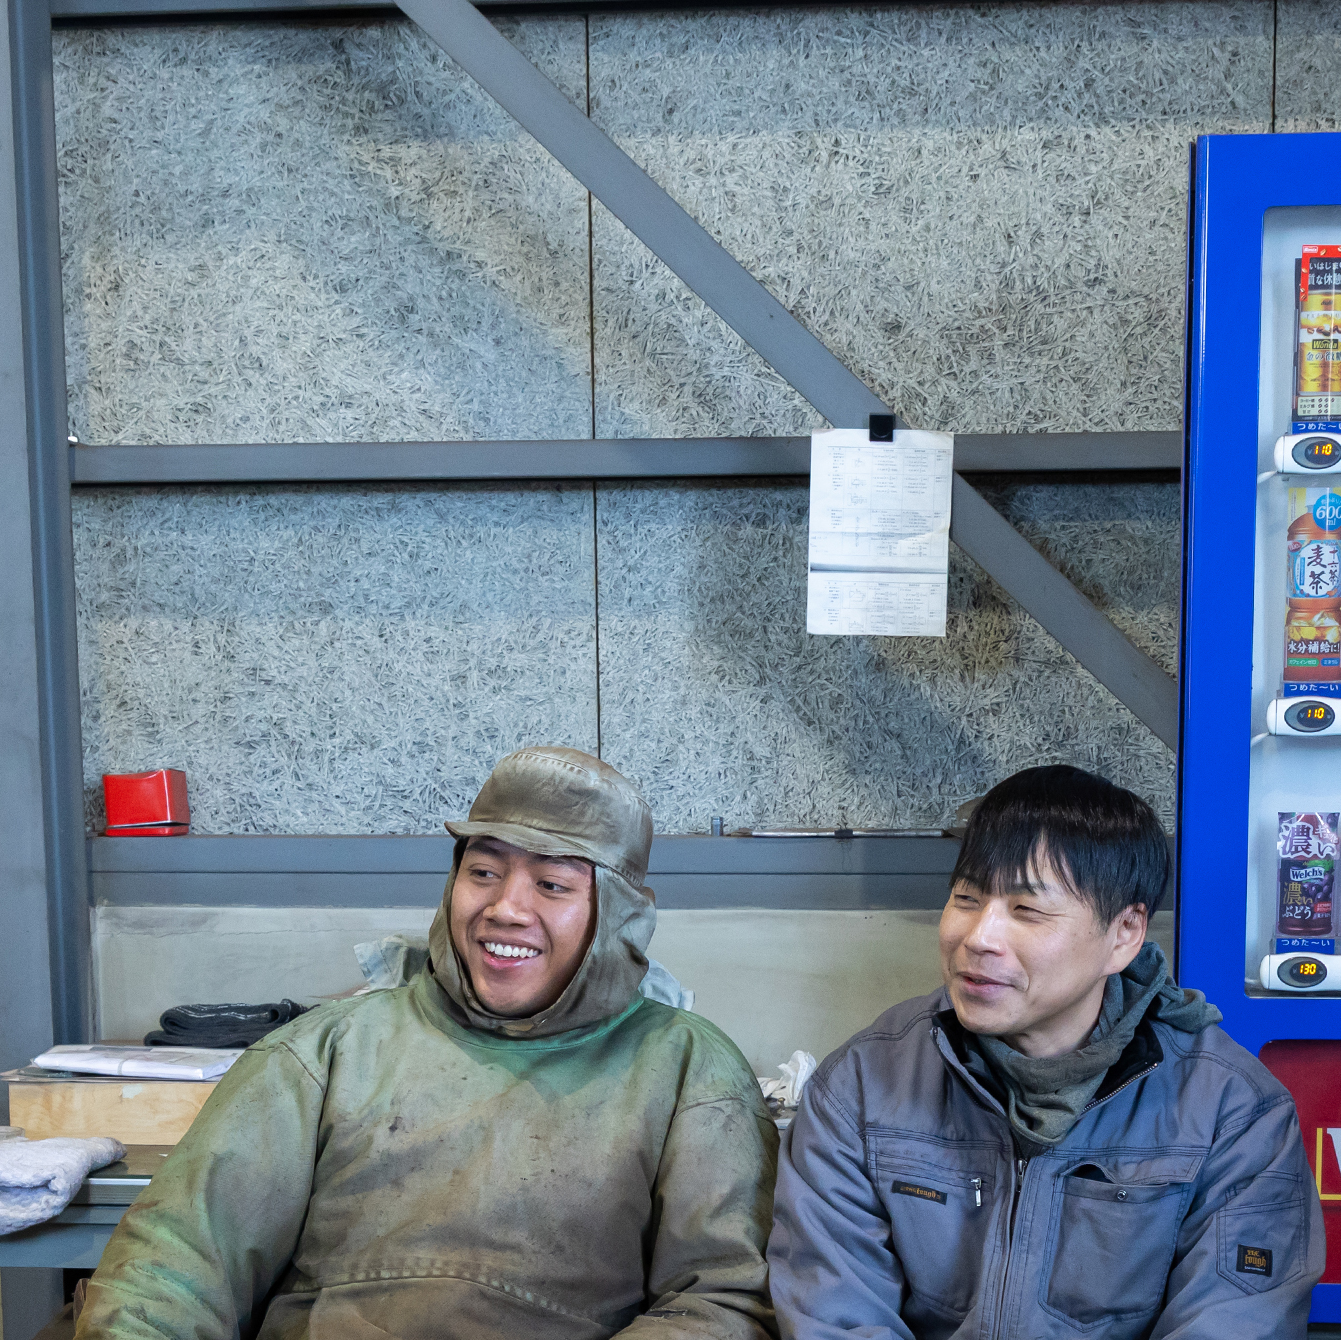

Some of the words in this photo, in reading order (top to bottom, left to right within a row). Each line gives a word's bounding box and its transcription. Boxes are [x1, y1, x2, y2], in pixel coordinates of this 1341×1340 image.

[1291, 869, 1323, 879] Welch's
[1282, 905, 1312, 919] ぶどう
[1300, 964, 1316, 975] 130
